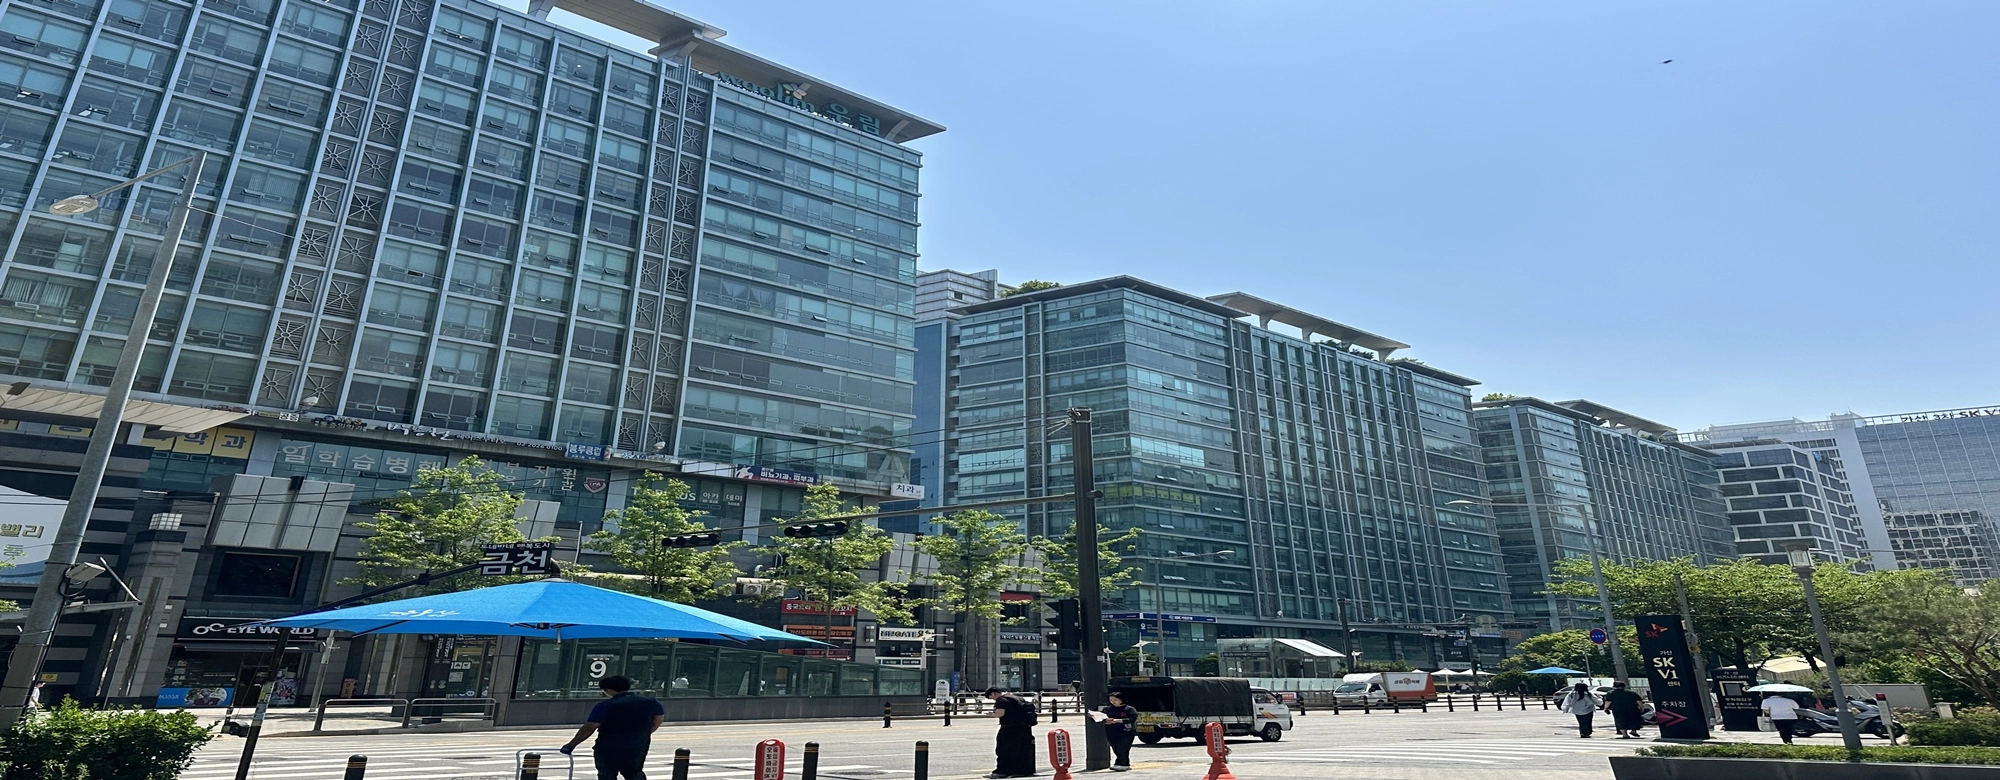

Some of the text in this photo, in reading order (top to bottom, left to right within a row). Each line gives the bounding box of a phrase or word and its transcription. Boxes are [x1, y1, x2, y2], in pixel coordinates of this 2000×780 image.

[712, 71, 816, 113] woolim
[827, 103, 880, 136] 우림
[1959, 410, 1980, 418] SK
[569, 443, 602, 457] 블루클럽
[895, 484, 915, 493] 치과
[0, 523, 45, 539] 밸리
[478, 550, 548, 575] 금천
[227, 626, 256, 635] EYE
[589, 660, 607, 679] 9
[1653, 657, 1676, 668] SK
[1657, 669, 1679, 680] V1
